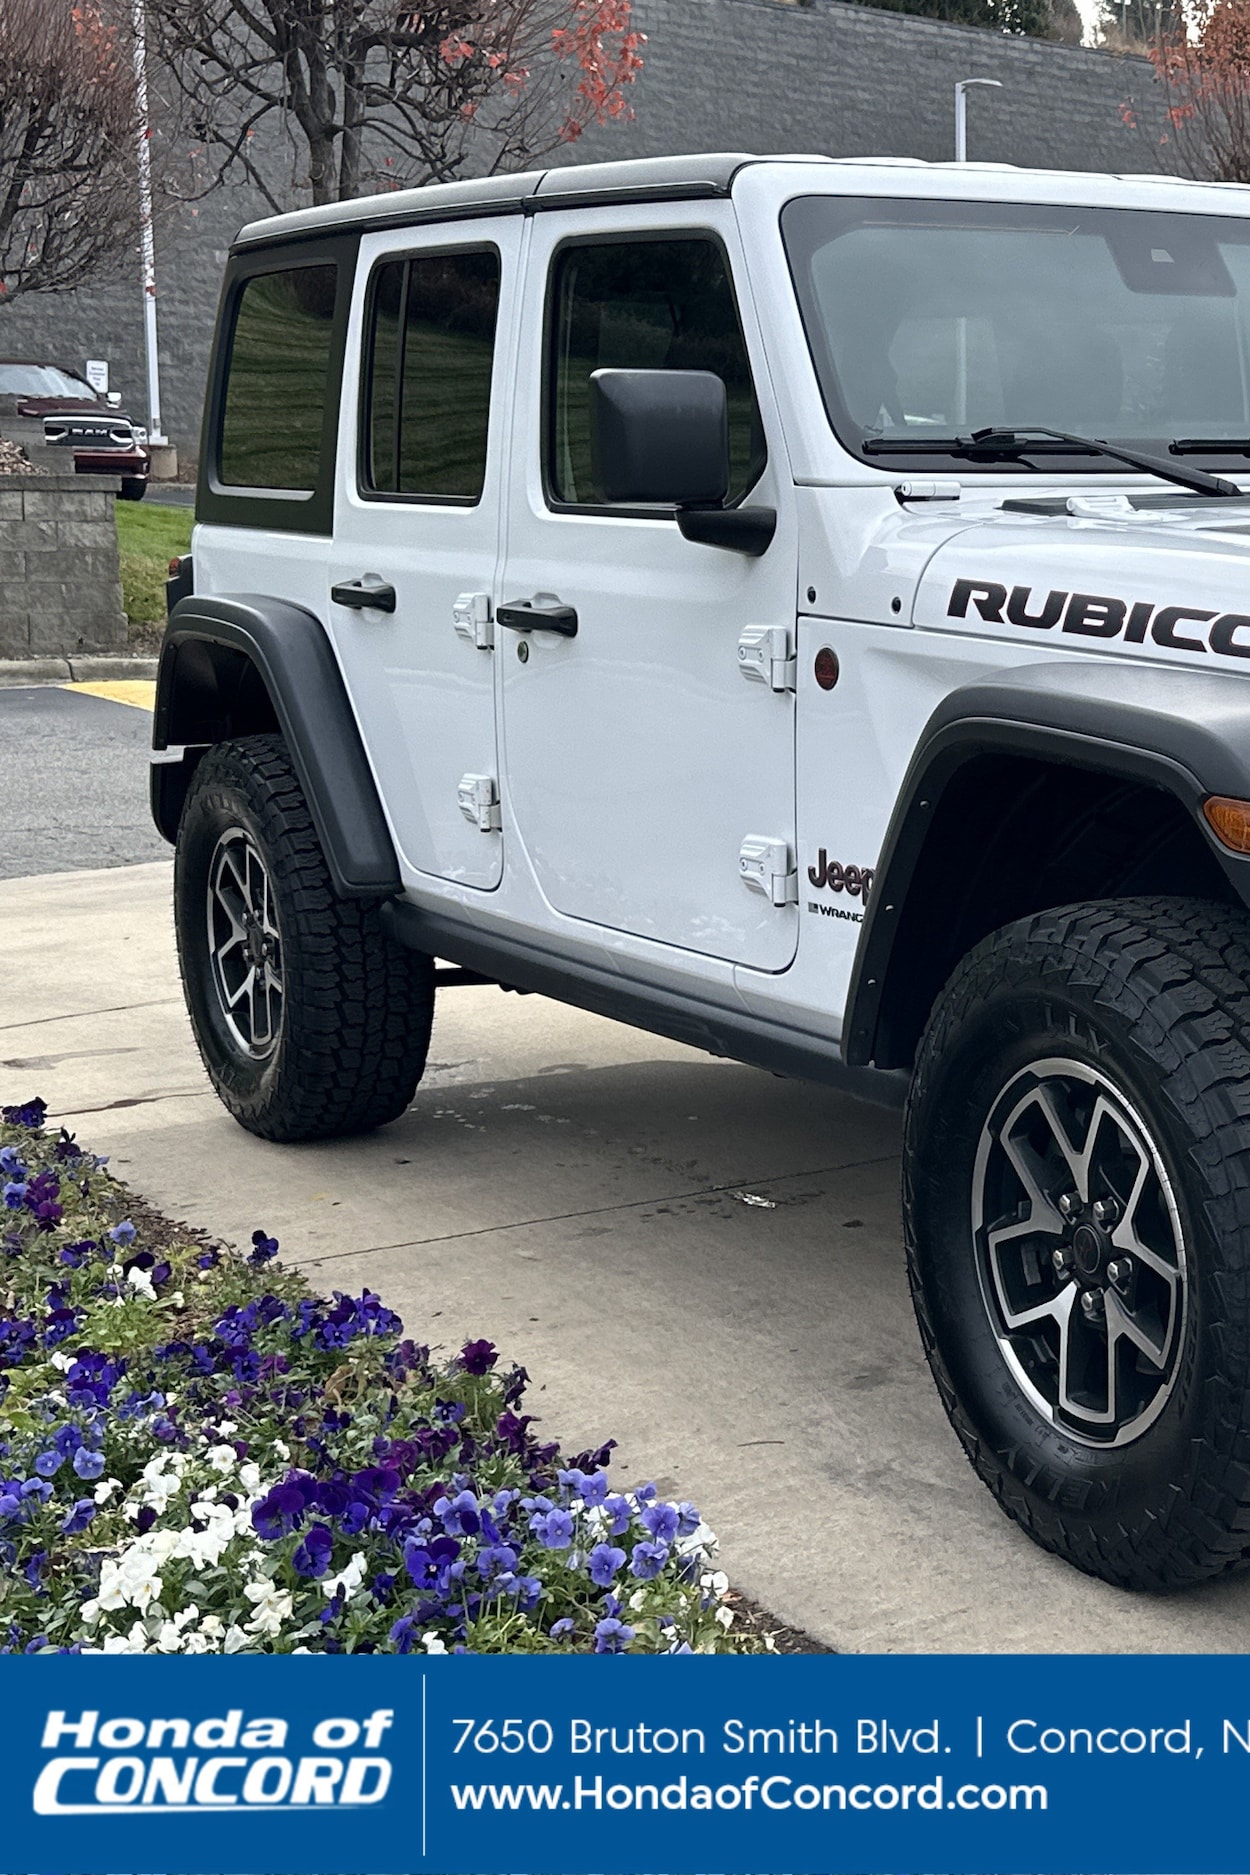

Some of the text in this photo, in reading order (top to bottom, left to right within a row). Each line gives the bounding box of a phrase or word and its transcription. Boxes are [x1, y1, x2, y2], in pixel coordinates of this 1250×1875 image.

[72, 428, 108, 436] RAM
[808, 848, 875, 906] Jeep
[820, 904, 865, 923] WRANG
